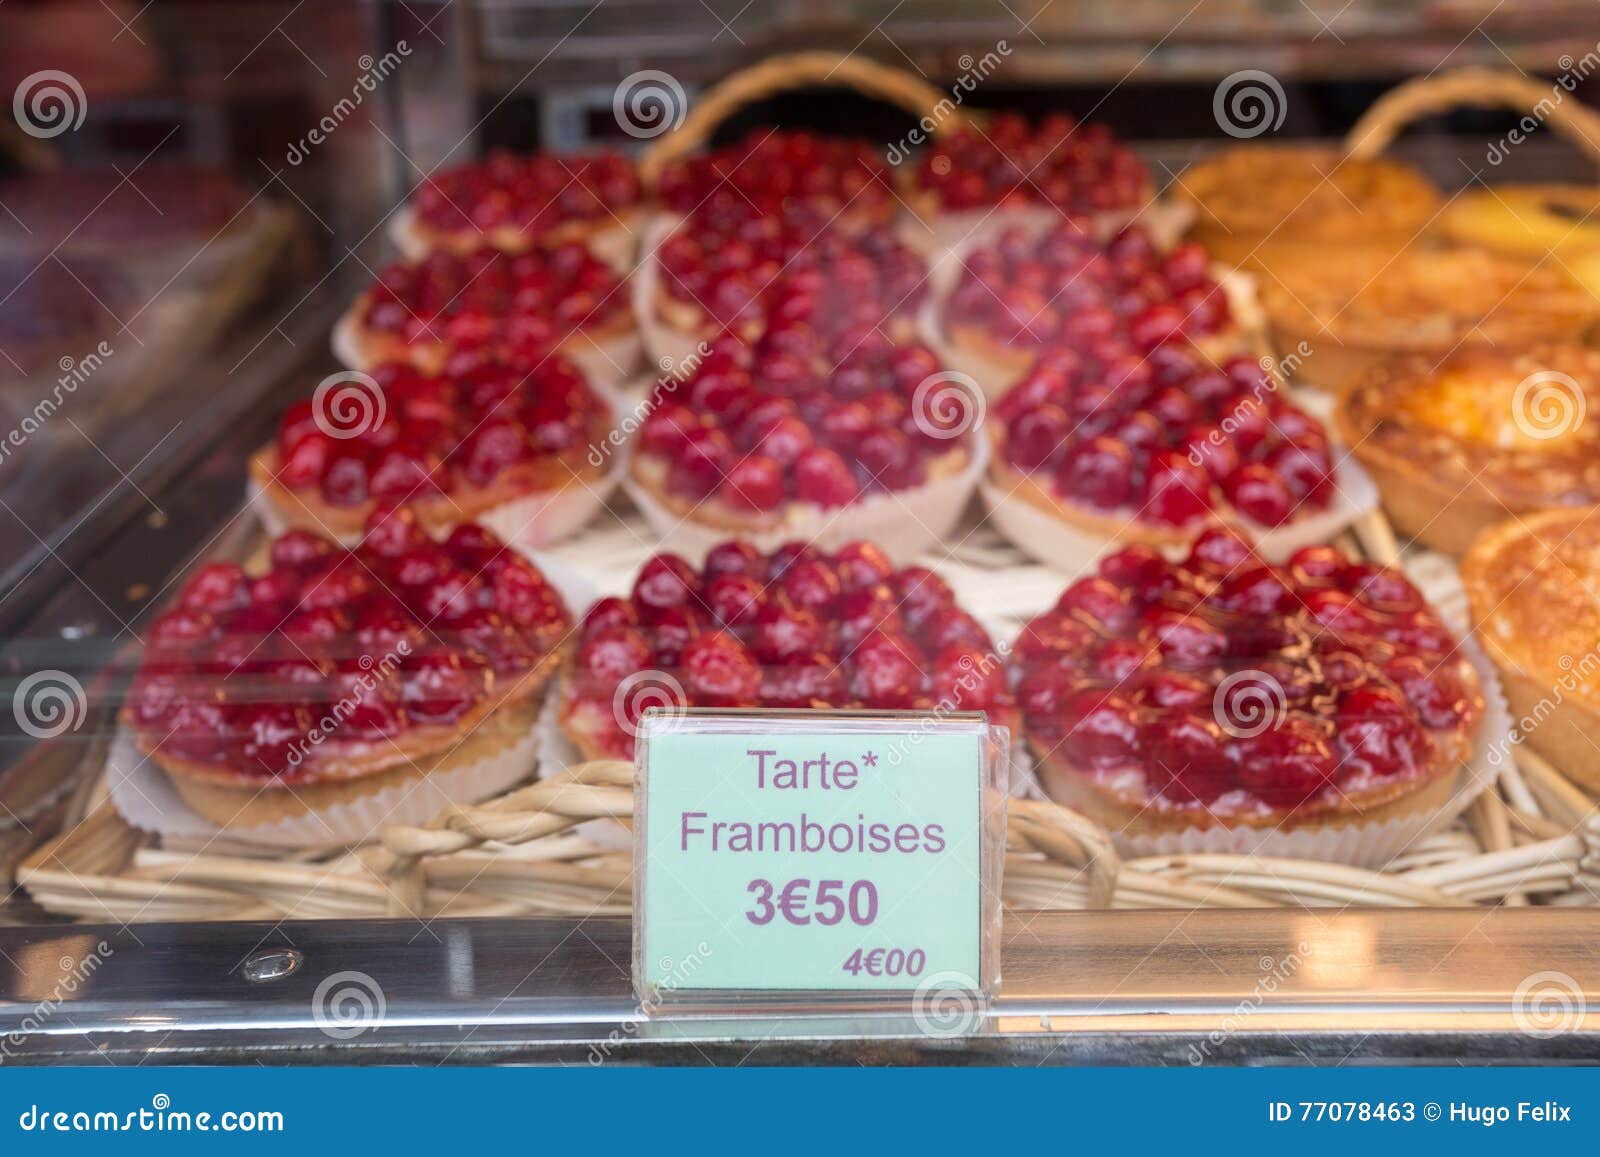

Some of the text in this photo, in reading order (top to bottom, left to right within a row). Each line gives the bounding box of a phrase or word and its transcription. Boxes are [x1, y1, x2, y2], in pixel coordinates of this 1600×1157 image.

[680, 812, 946, 853] Framboises
[745, 878, 879, 926] 3€50
[842, 948, 926, 976] 4€00
